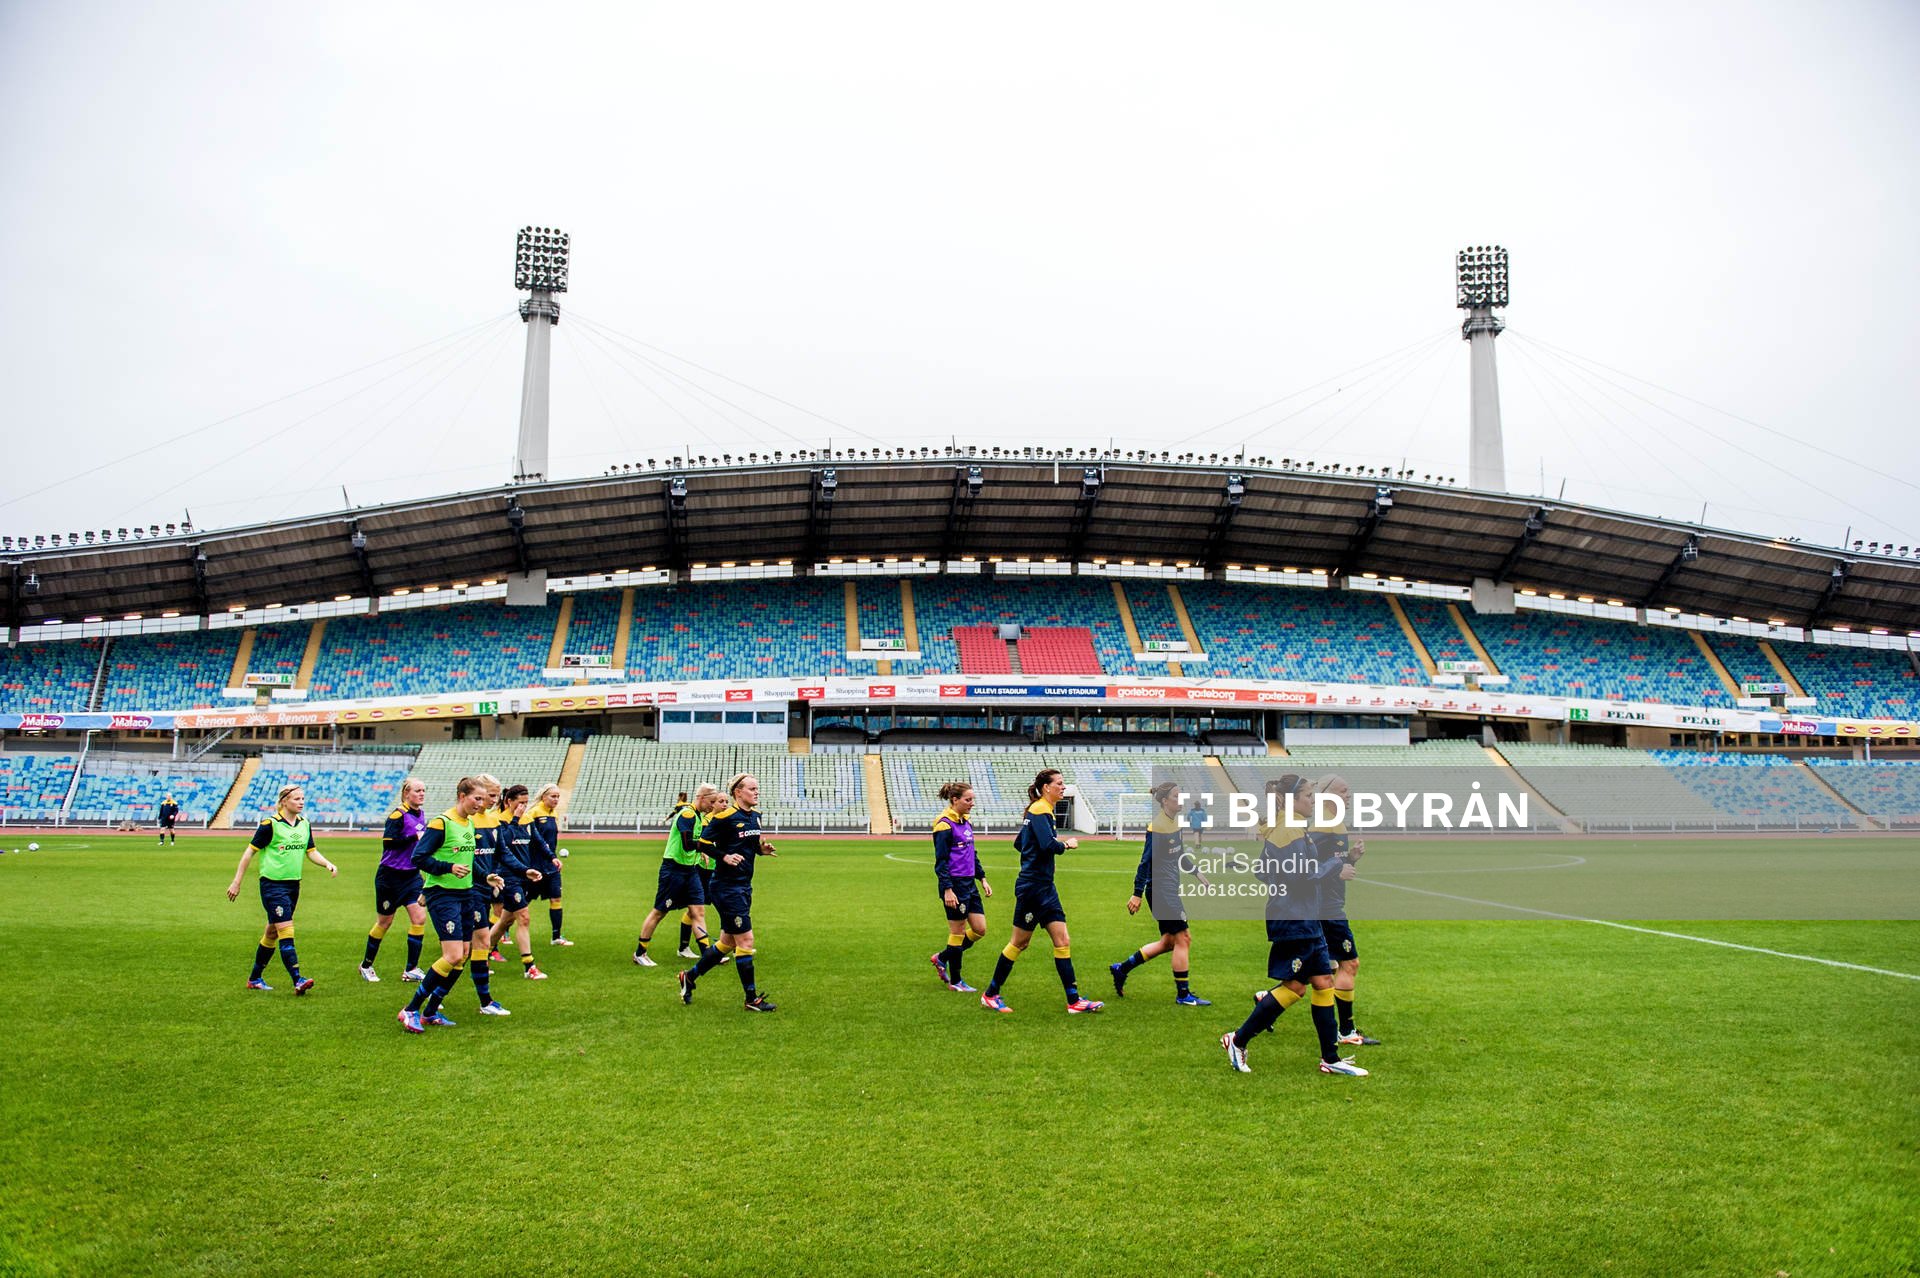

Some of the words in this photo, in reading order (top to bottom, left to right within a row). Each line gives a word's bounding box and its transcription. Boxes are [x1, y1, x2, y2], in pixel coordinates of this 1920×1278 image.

[764, 689, 796, 698] Shopping
[836, 688, 866, 696] Shopping
[906, 686, 938, 695] Shopping
[691, 692, 723, 701] Shopping
[277, 712, 318, 724] Renova
[1607, 710, 1646, 720] PEAB
[26, 715, 61, 727] Malaco
[115, 716, 150, 728] Malaco
[196, 715, 236, 726] Renova
[1682, 716, 1720, 726] PEAB
[1784, 722, 1815, 733] Malaco
